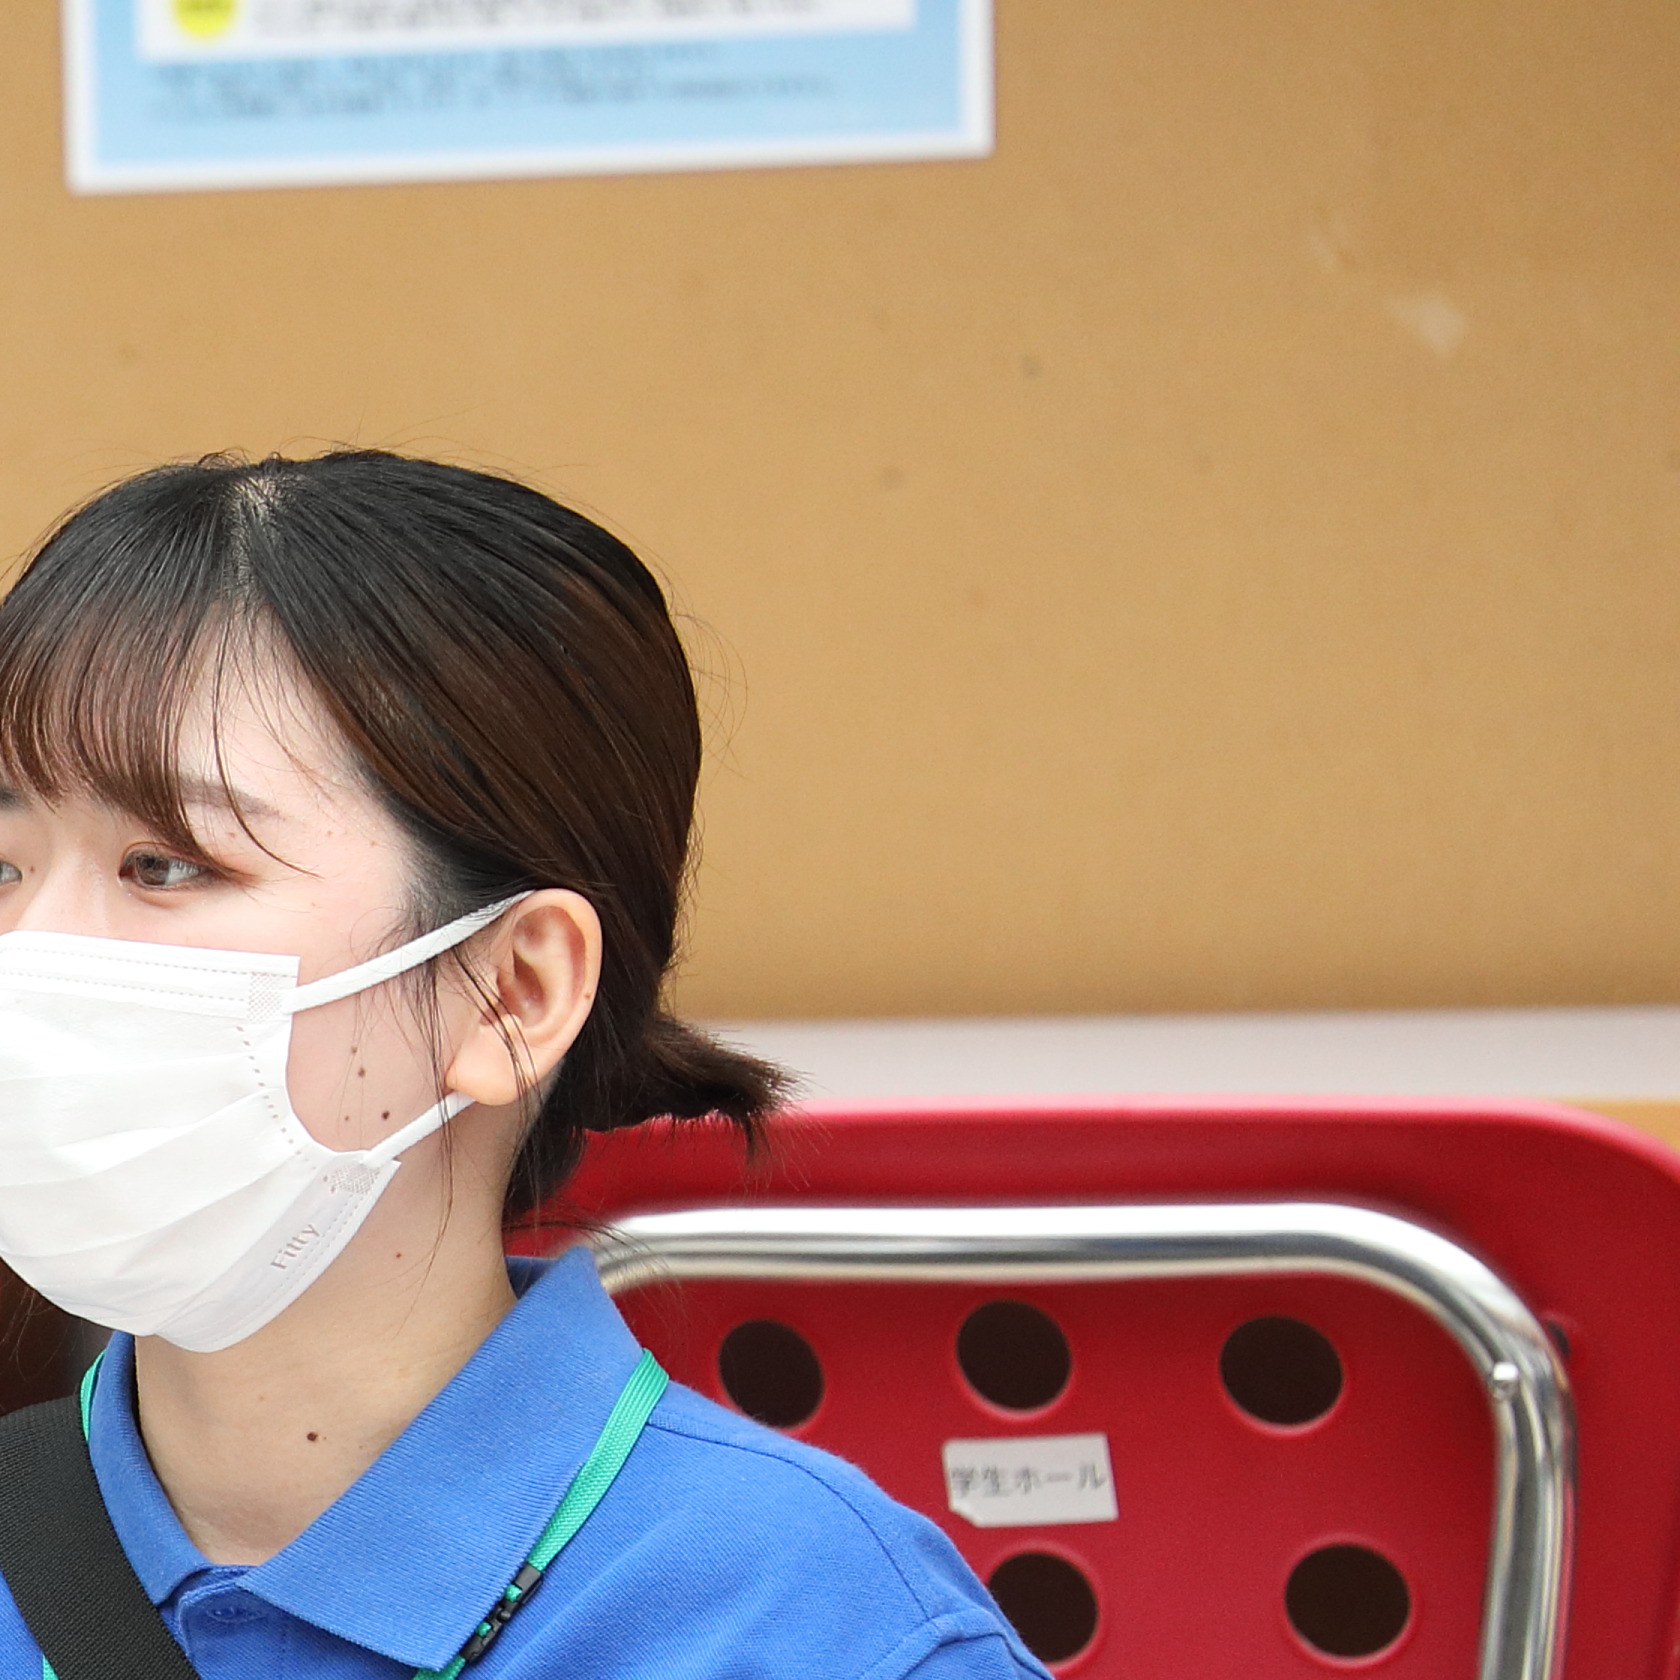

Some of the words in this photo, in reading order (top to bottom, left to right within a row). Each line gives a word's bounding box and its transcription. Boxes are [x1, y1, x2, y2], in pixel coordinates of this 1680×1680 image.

[951, 1463, 1107, 1498] 学生ホール
